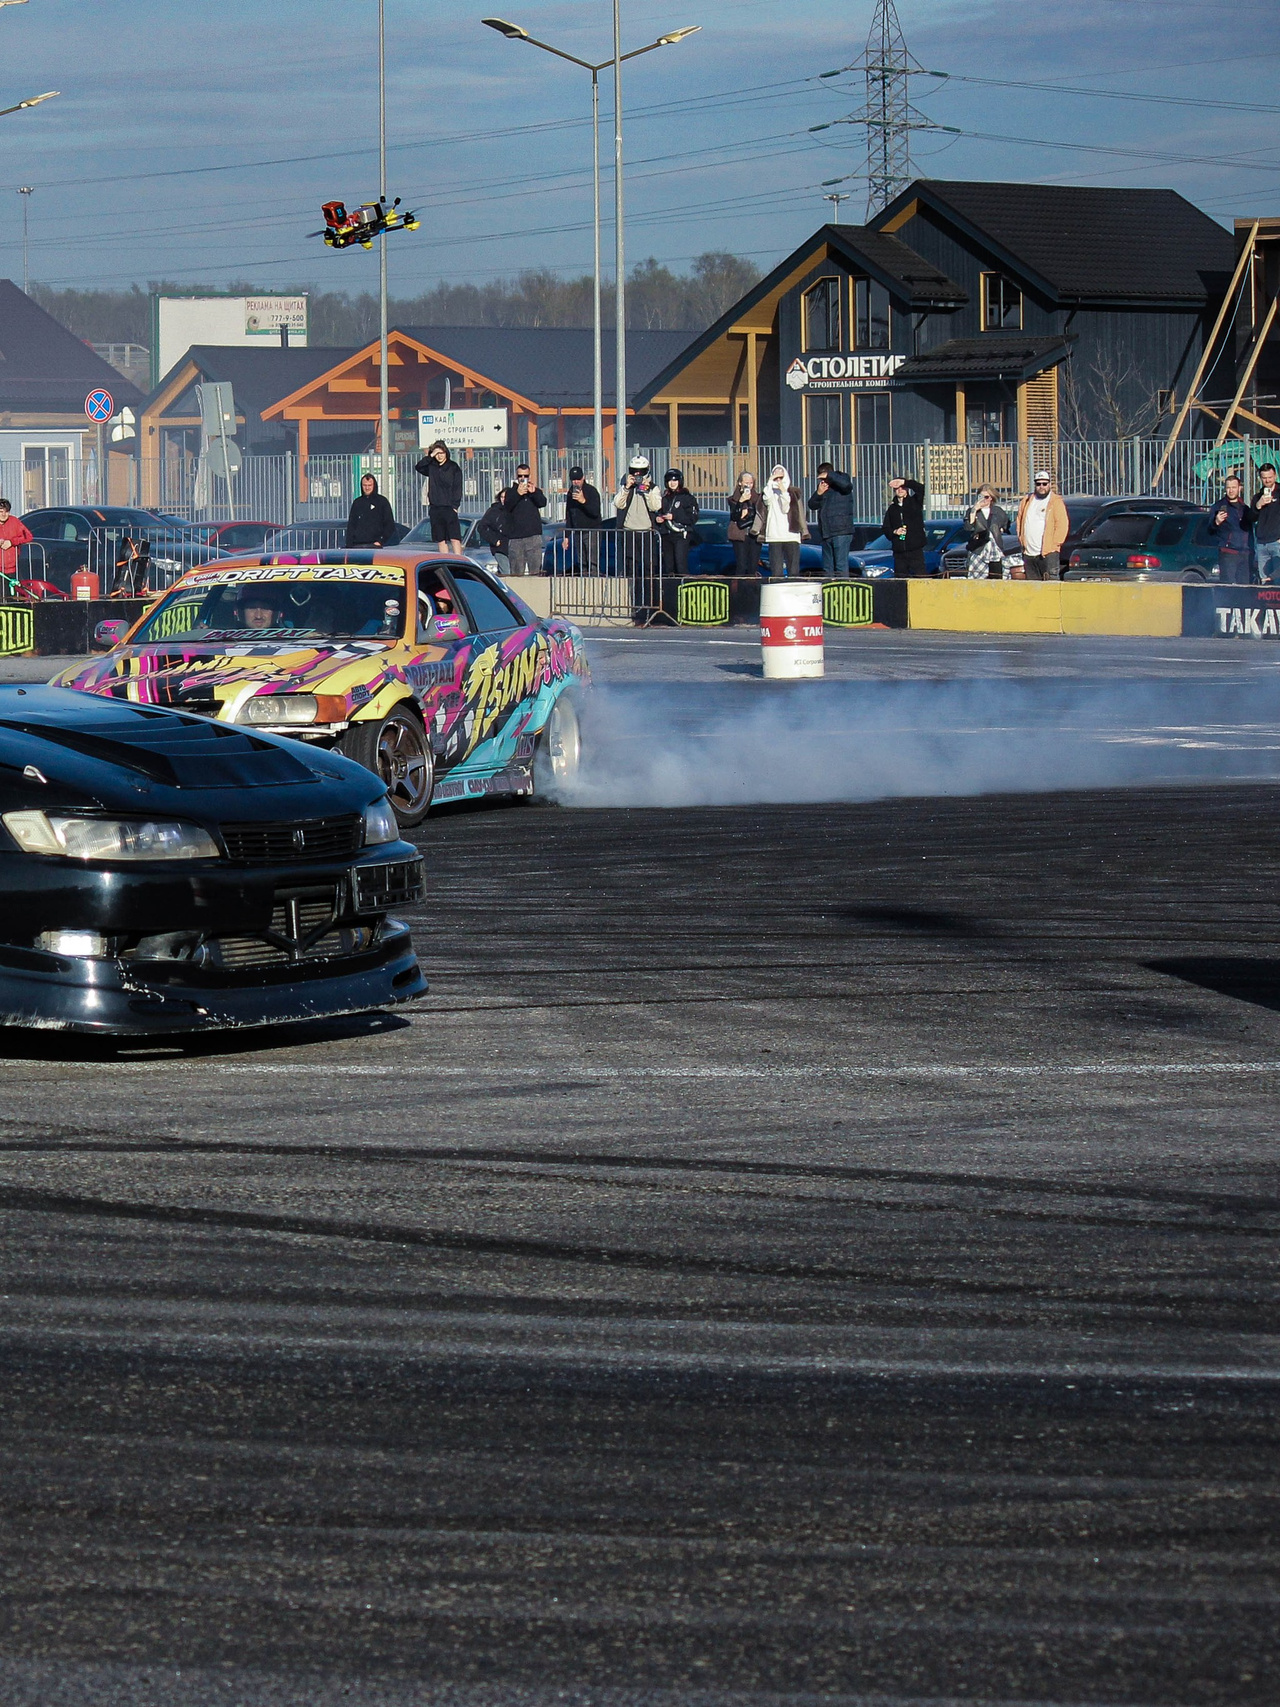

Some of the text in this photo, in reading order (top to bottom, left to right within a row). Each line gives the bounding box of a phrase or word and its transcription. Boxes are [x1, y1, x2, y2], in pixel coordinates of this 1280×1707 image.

[809, 381, 863, 389] СТРОИТЕЛЬНАЯ
[448, 425, 484, 433] СТРОИТЕЛЕЙ
[220, 568, 308, 583] DRIFT
[312, 567, 378, 580] TAXI
[681, 585, 727, 622] TRIALLI
[823, 585, 869, 622] TRIALLI
